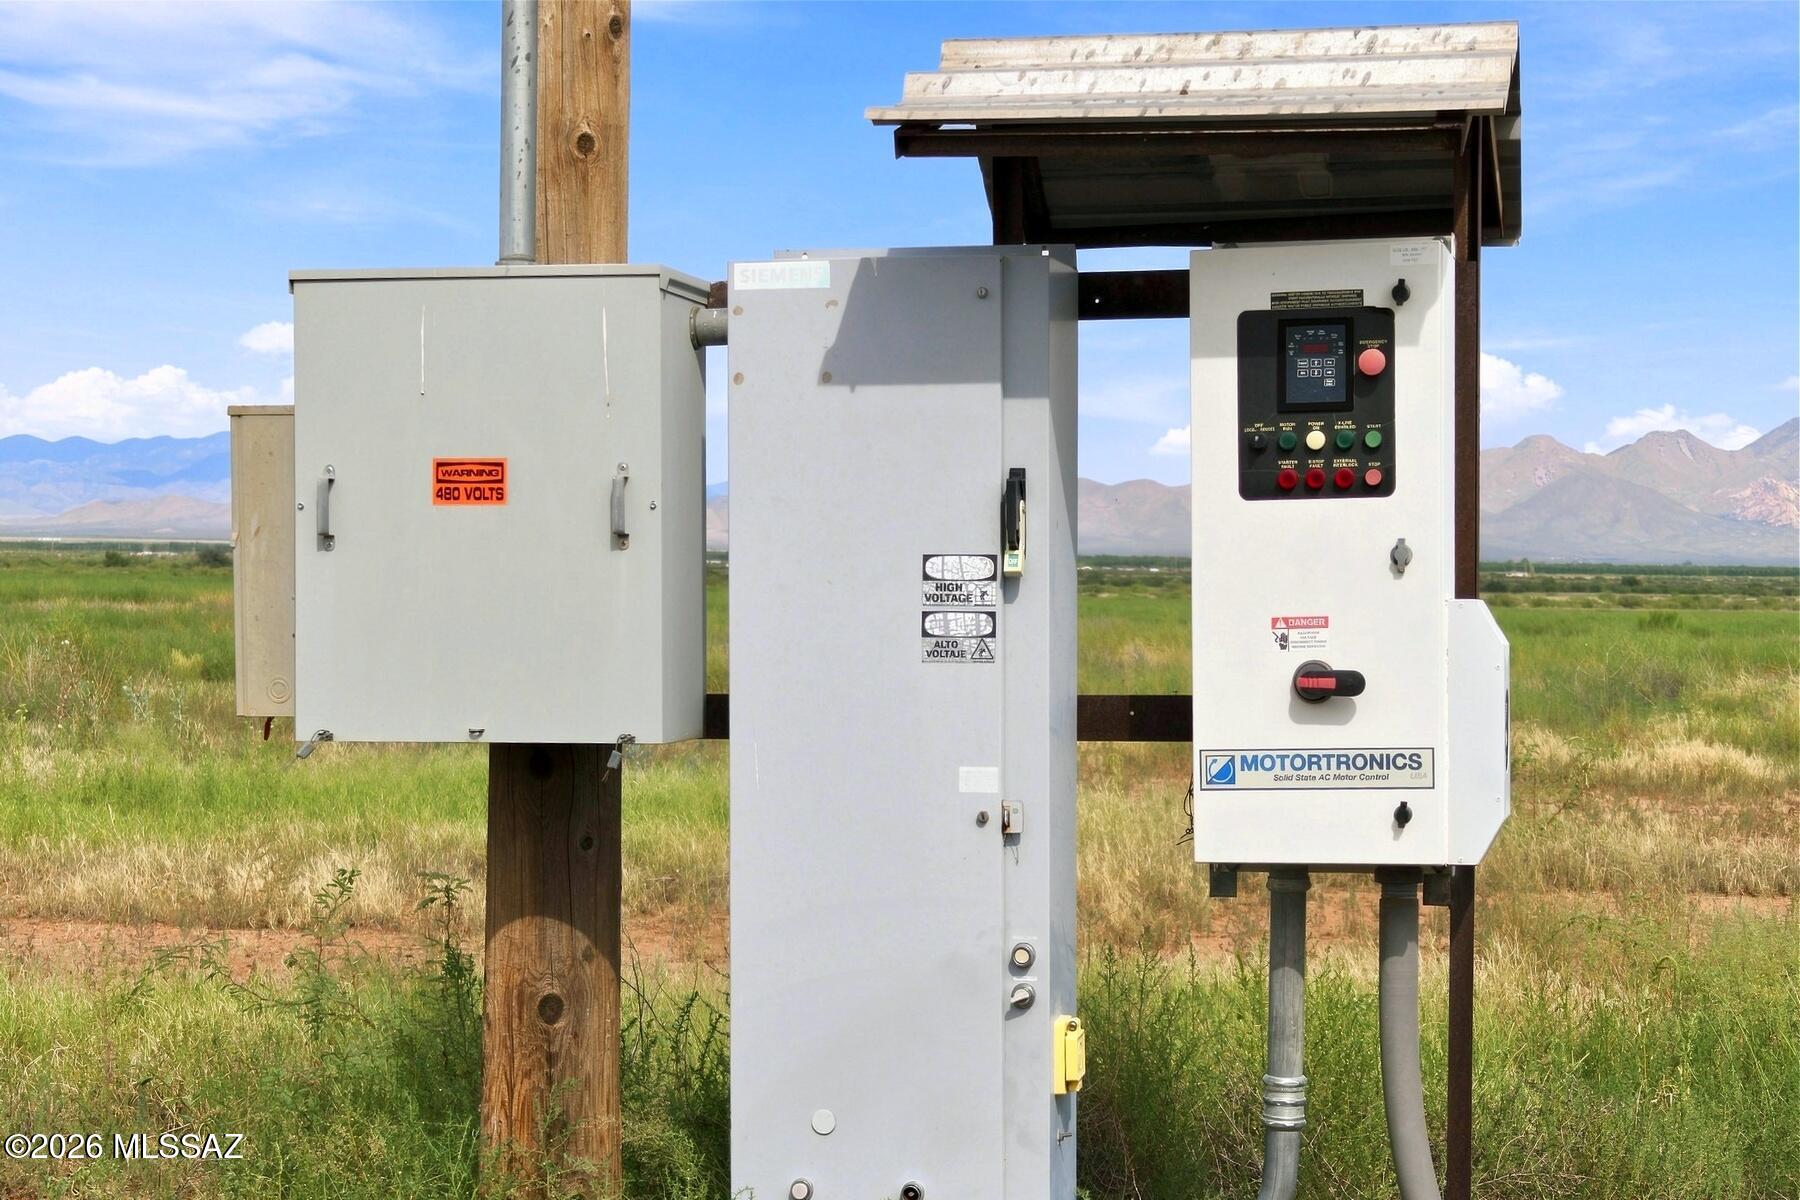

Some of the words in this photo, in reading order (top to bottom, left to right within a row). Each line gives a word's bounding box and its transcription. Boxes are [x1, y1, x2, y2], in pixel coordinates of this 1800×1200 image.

[441, 469, 500, 477] WARNING
[436, 486, 460, 500] 480
[464, 486, 504, 500] VOLTS
[935, 583, 963, 592] HIGH
[924, 593, 973, 603] VOLTAGE
[1288, 618, 1326, 627] DANGER
[933, 640, 959, 649] ALTO
[925, 649, 967, 658] VOLTAJE
[1240, 753, 1423, 772] MOTORTRONICS
[1273, 774, 1293, 782] Solid
[1295, 773, 1317, 782] State
[1318, 773, 1331, 781] AC
[1333, 773, 1357, 781] Motor
[1358, 773, 1389, 781] Control
